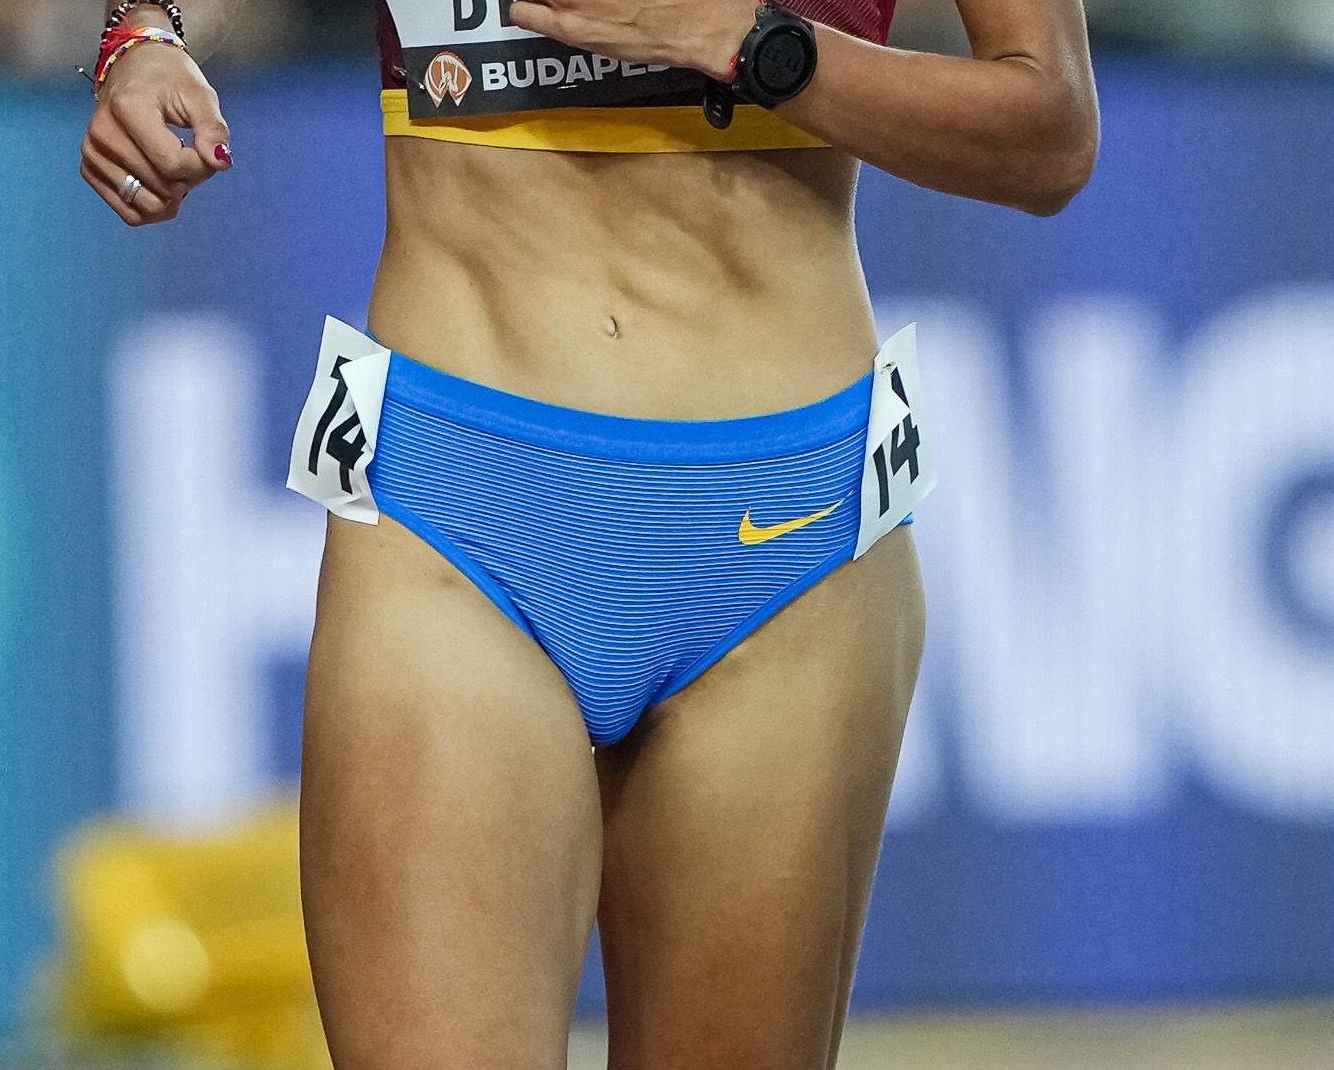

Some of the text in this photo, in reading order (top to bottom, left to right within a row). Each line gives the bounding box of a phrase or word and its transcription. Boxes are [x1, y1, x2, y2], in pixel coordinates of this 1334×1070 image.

[481, 52, 671, 92] BUDAPE
[308, 355, 367, 495] 14
[872, 367, 921, 519] 14
